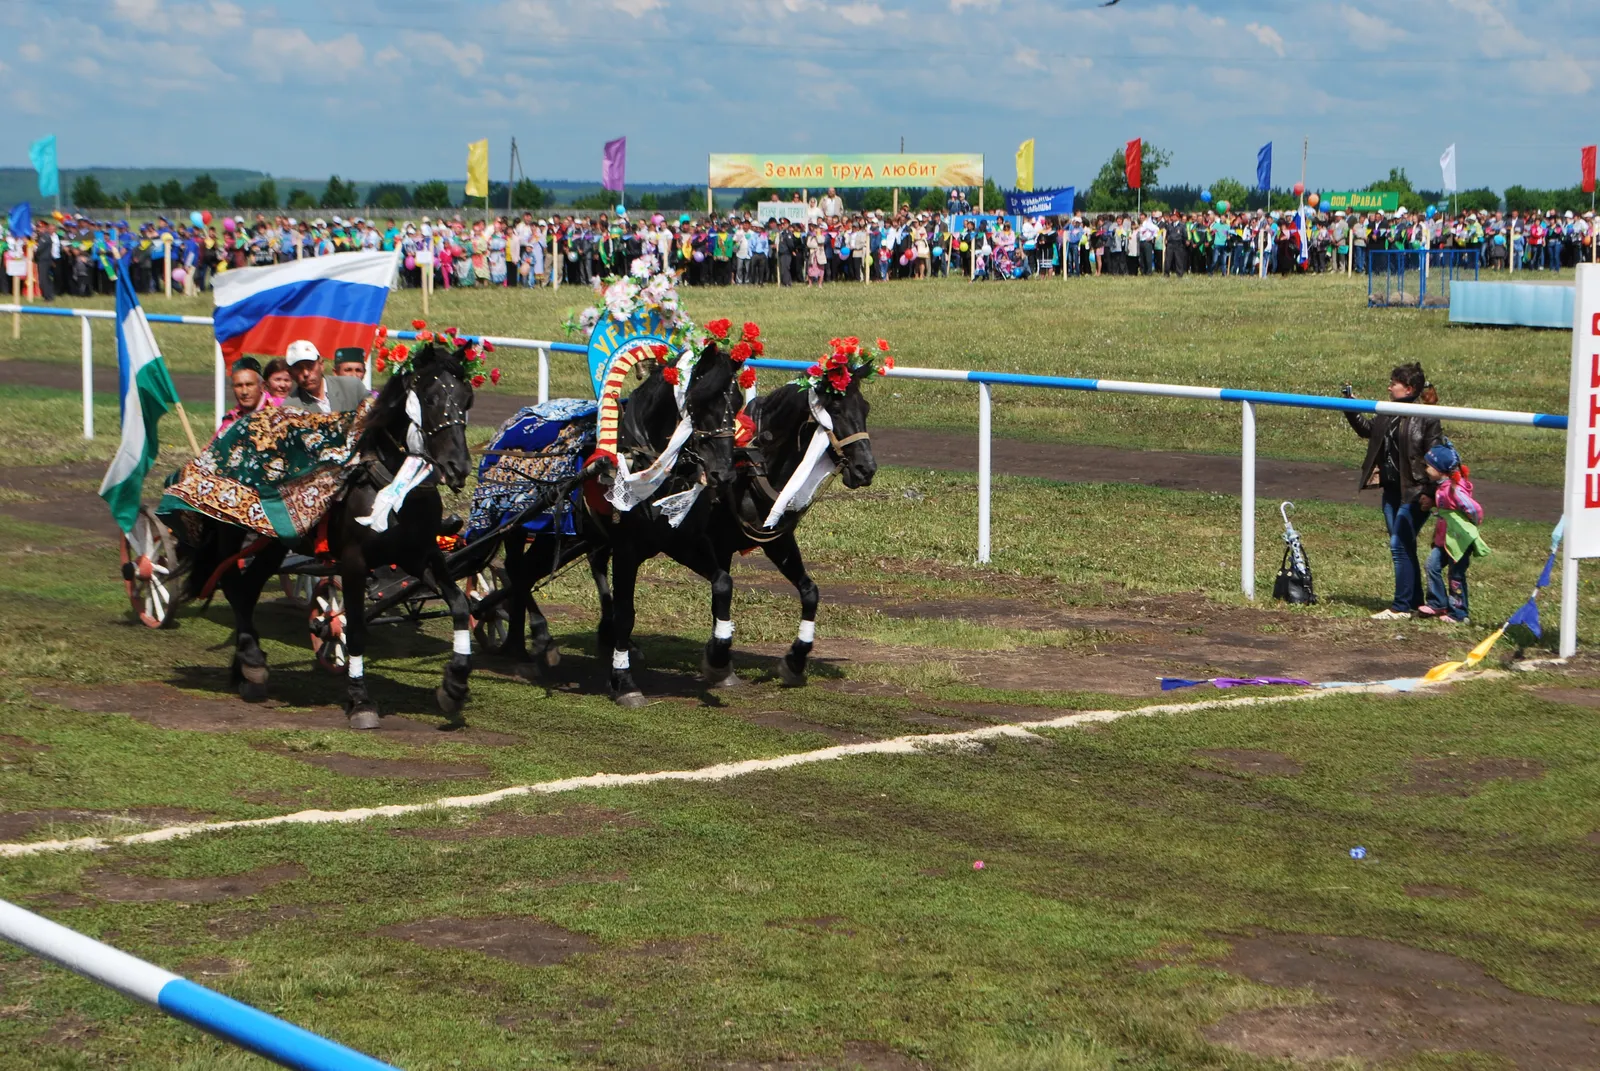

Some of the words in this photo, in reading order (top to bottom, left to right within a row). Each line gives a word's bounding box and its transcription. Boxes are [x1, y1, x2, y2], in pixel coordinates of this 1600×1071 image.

[765, 162, 823, 177] Земля
[831, 164, 875, 180] труд
[882, 162, 938, 177] любит
[1330, 195, 1347, 207] ООО
